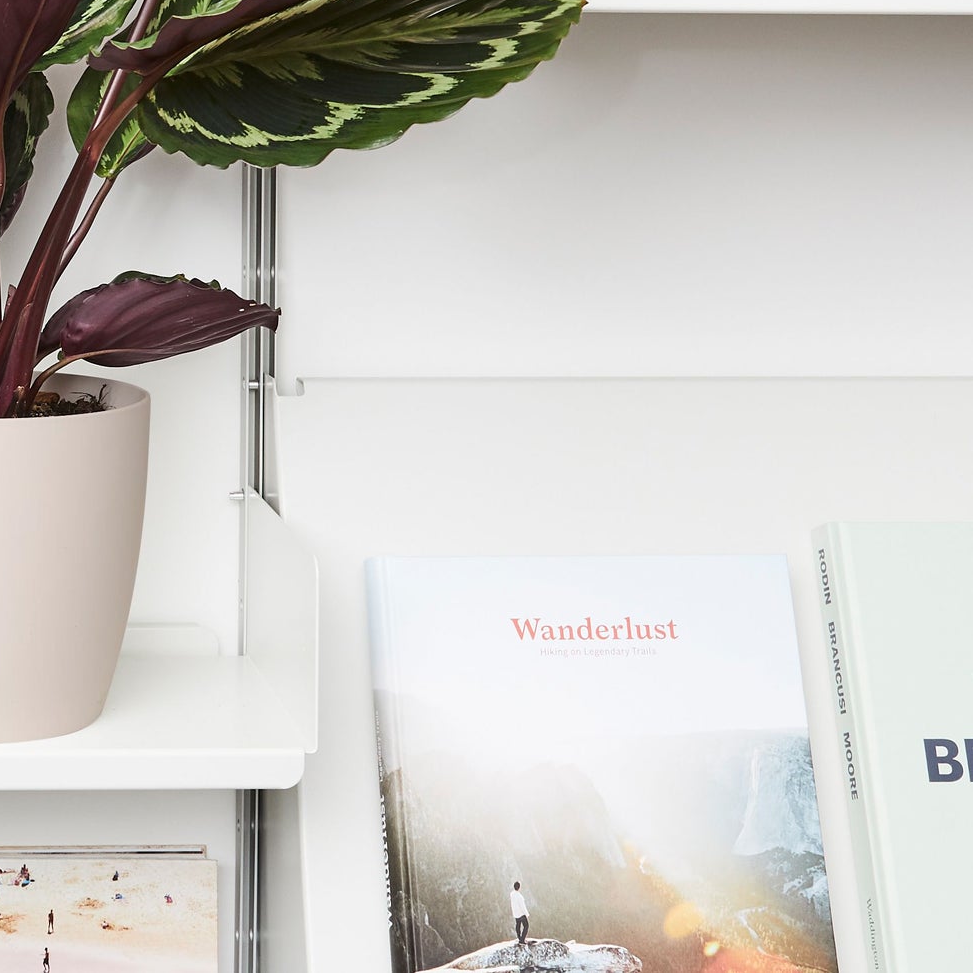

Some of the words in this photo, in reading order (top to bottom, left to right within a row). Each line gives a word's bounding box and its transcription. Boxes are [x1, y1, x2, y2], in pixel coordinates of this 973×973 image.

[510, 616, 679, 640] Wanderlust
[540, 647, 568, 658] Hiking
[584, 647, 630, 658] Legendary
[631, 647, 657, 656] Trails
[818, 548, 832, 606] RODIN
[827, 621, 847, 716] BRANCUSI
[842, 731, 859, 801] MOORE
[865, 898, 880, 970] Waddington
